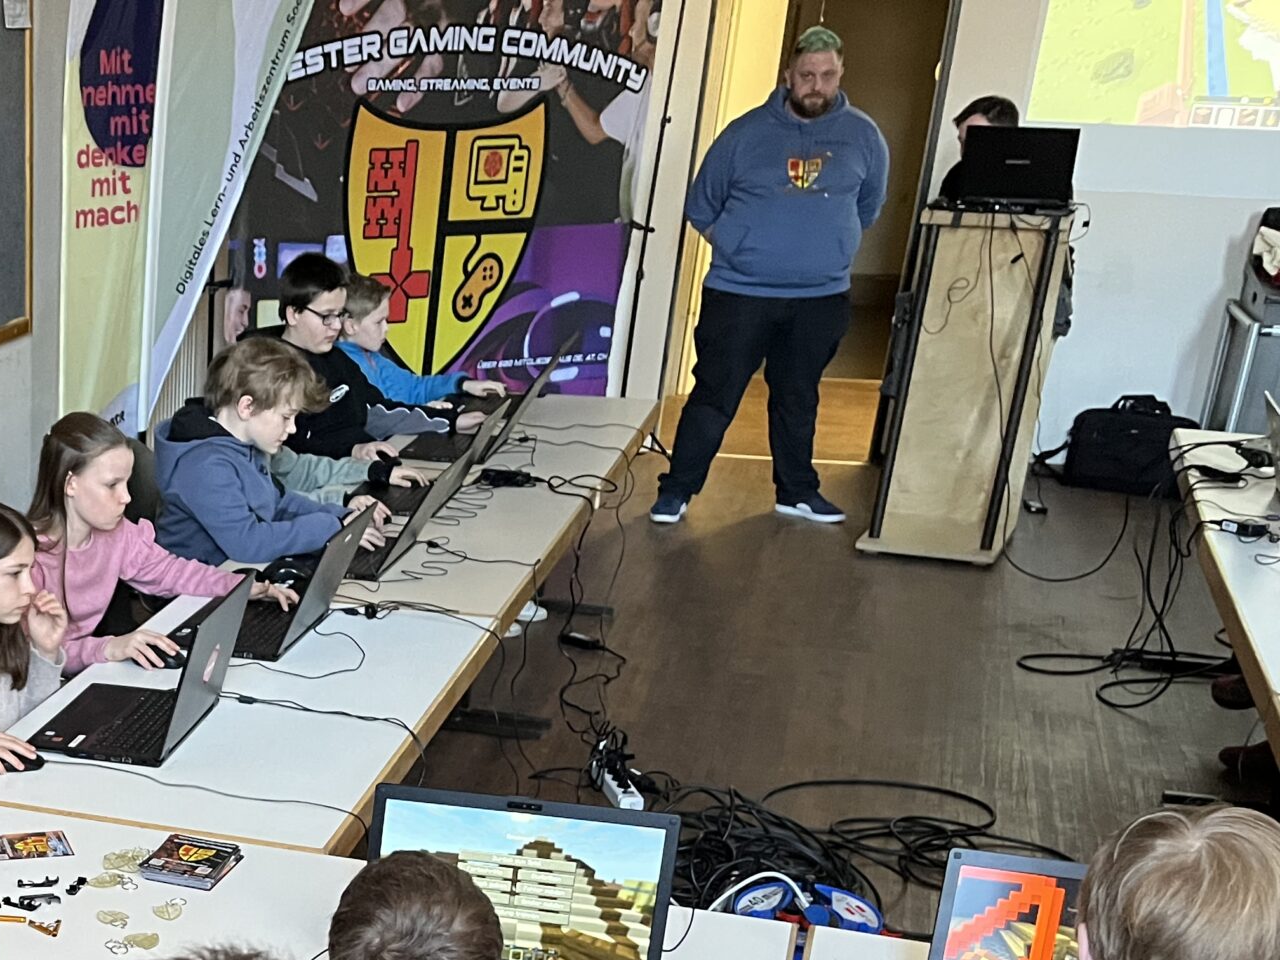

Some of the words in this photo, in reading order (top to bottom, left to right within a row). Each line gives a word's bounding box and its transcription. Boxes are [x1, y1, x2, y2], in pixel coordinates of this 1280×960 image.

[99, 46, 134, 76] Mit
[389, 26, 497, 56] GAMING
[501, 28, 648, 91] COMMUNITY
[368, 78, 417, 92] GAMING,
[419, 77, 491, 92] STREAMING,
[493, 77, 541, 91] EVENTS
[109, 107, 150, 137] mit
[175, 229, 210, 295] Digitales
[204, 185, 228, 228] Lern-
[225, 152, 242, 183] und
[239, 29, 291, 151] Arbeitszentrum
[91, 170, 132, 198] mit
[75, 201, 140, 229] mach
